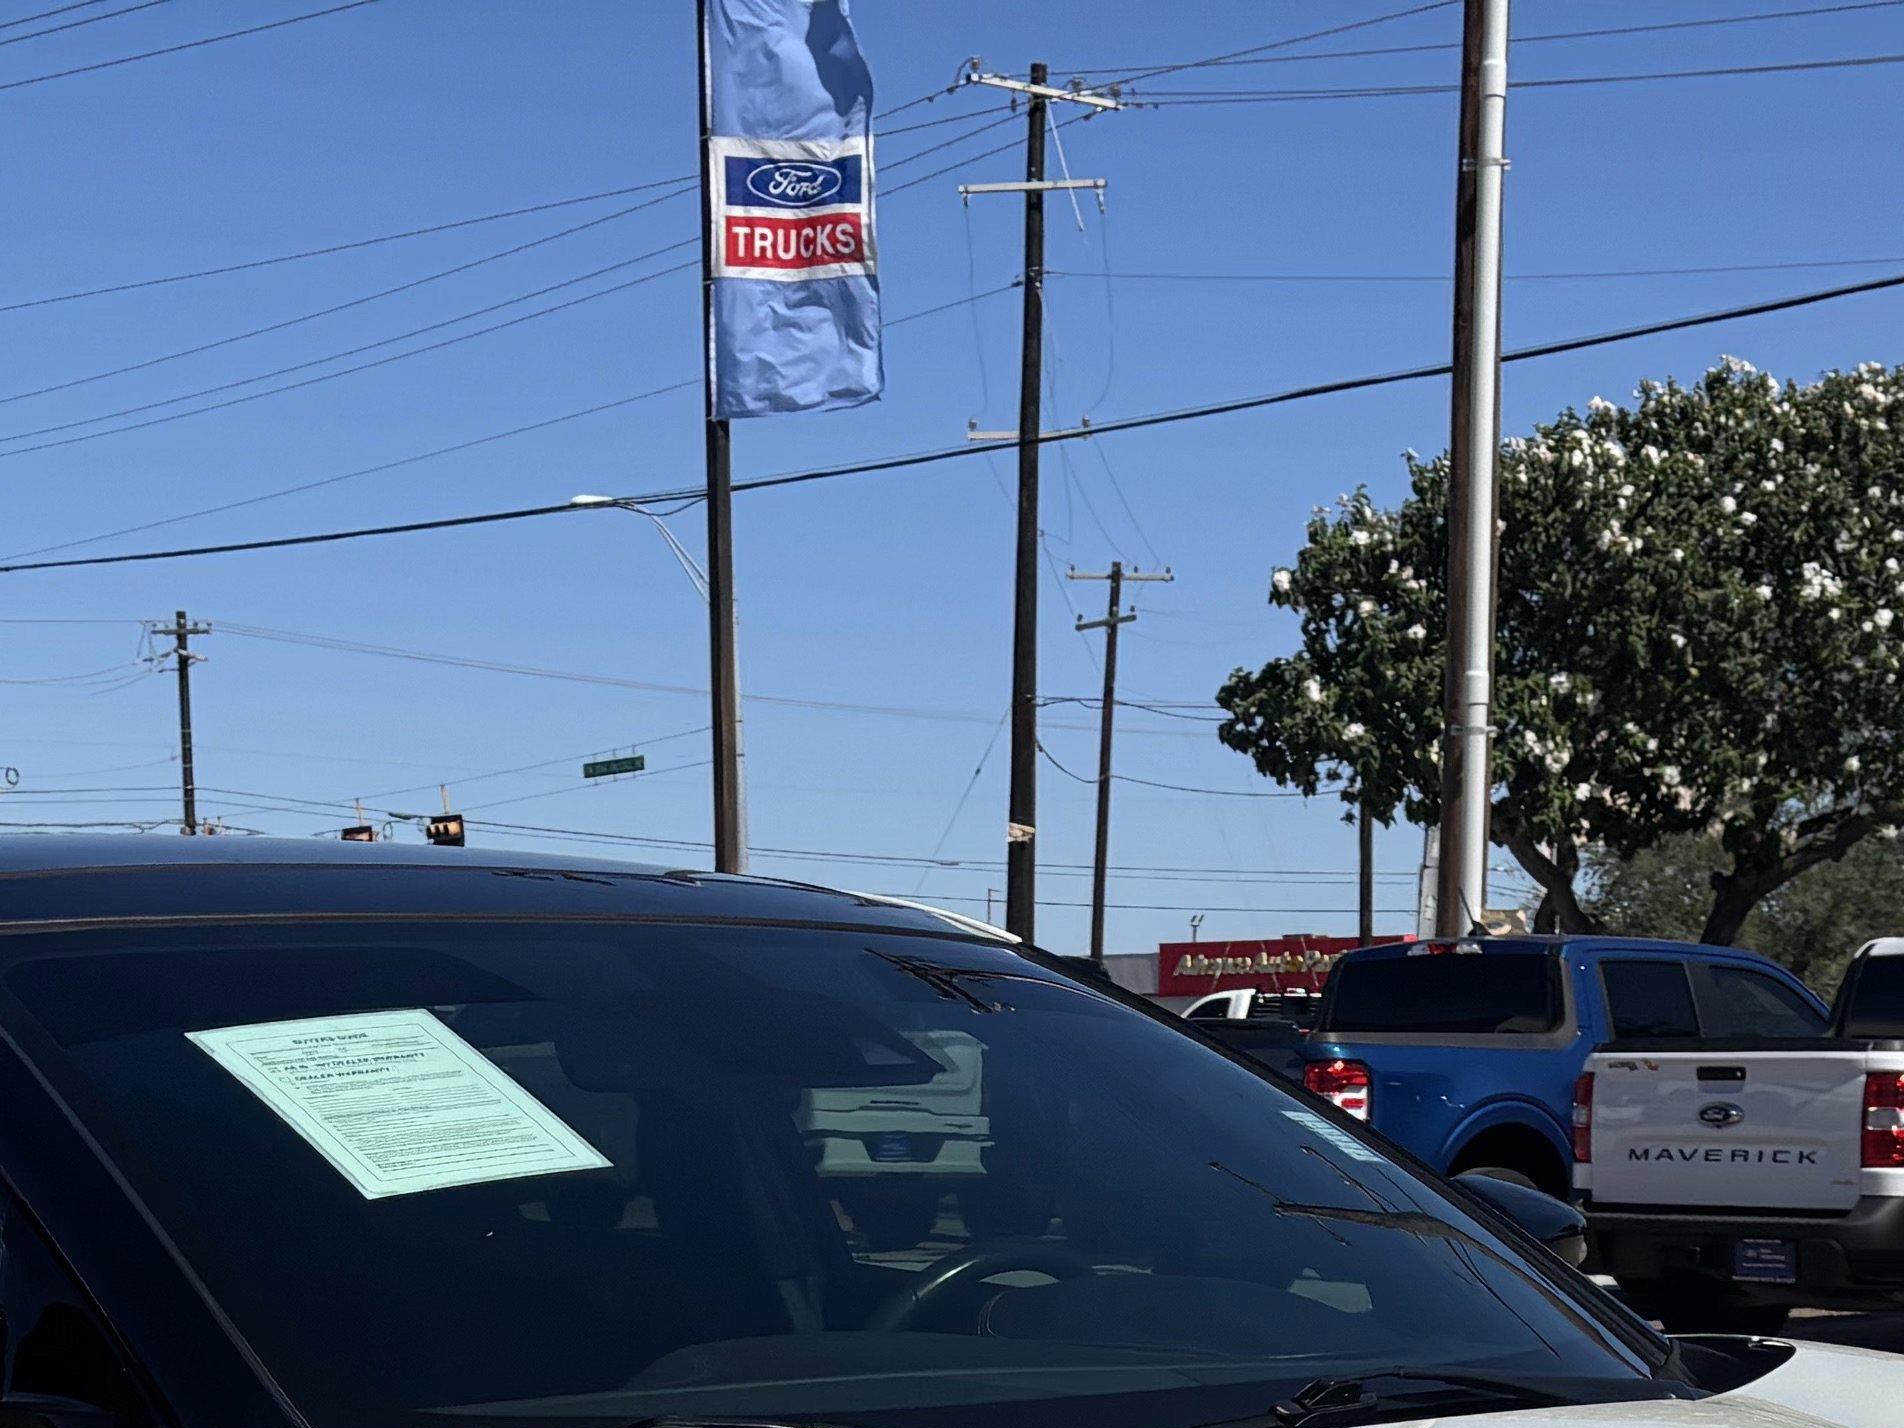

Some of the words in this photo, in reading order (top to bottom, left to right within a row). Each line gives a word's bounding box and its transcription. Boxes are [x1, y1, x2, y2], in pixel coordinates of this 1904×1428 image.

[769, 168, 827, 196] Ford
[731, 222, 856, 260] TRUCKS
[1628, 1148, 1818, 1164] MAVERICK
